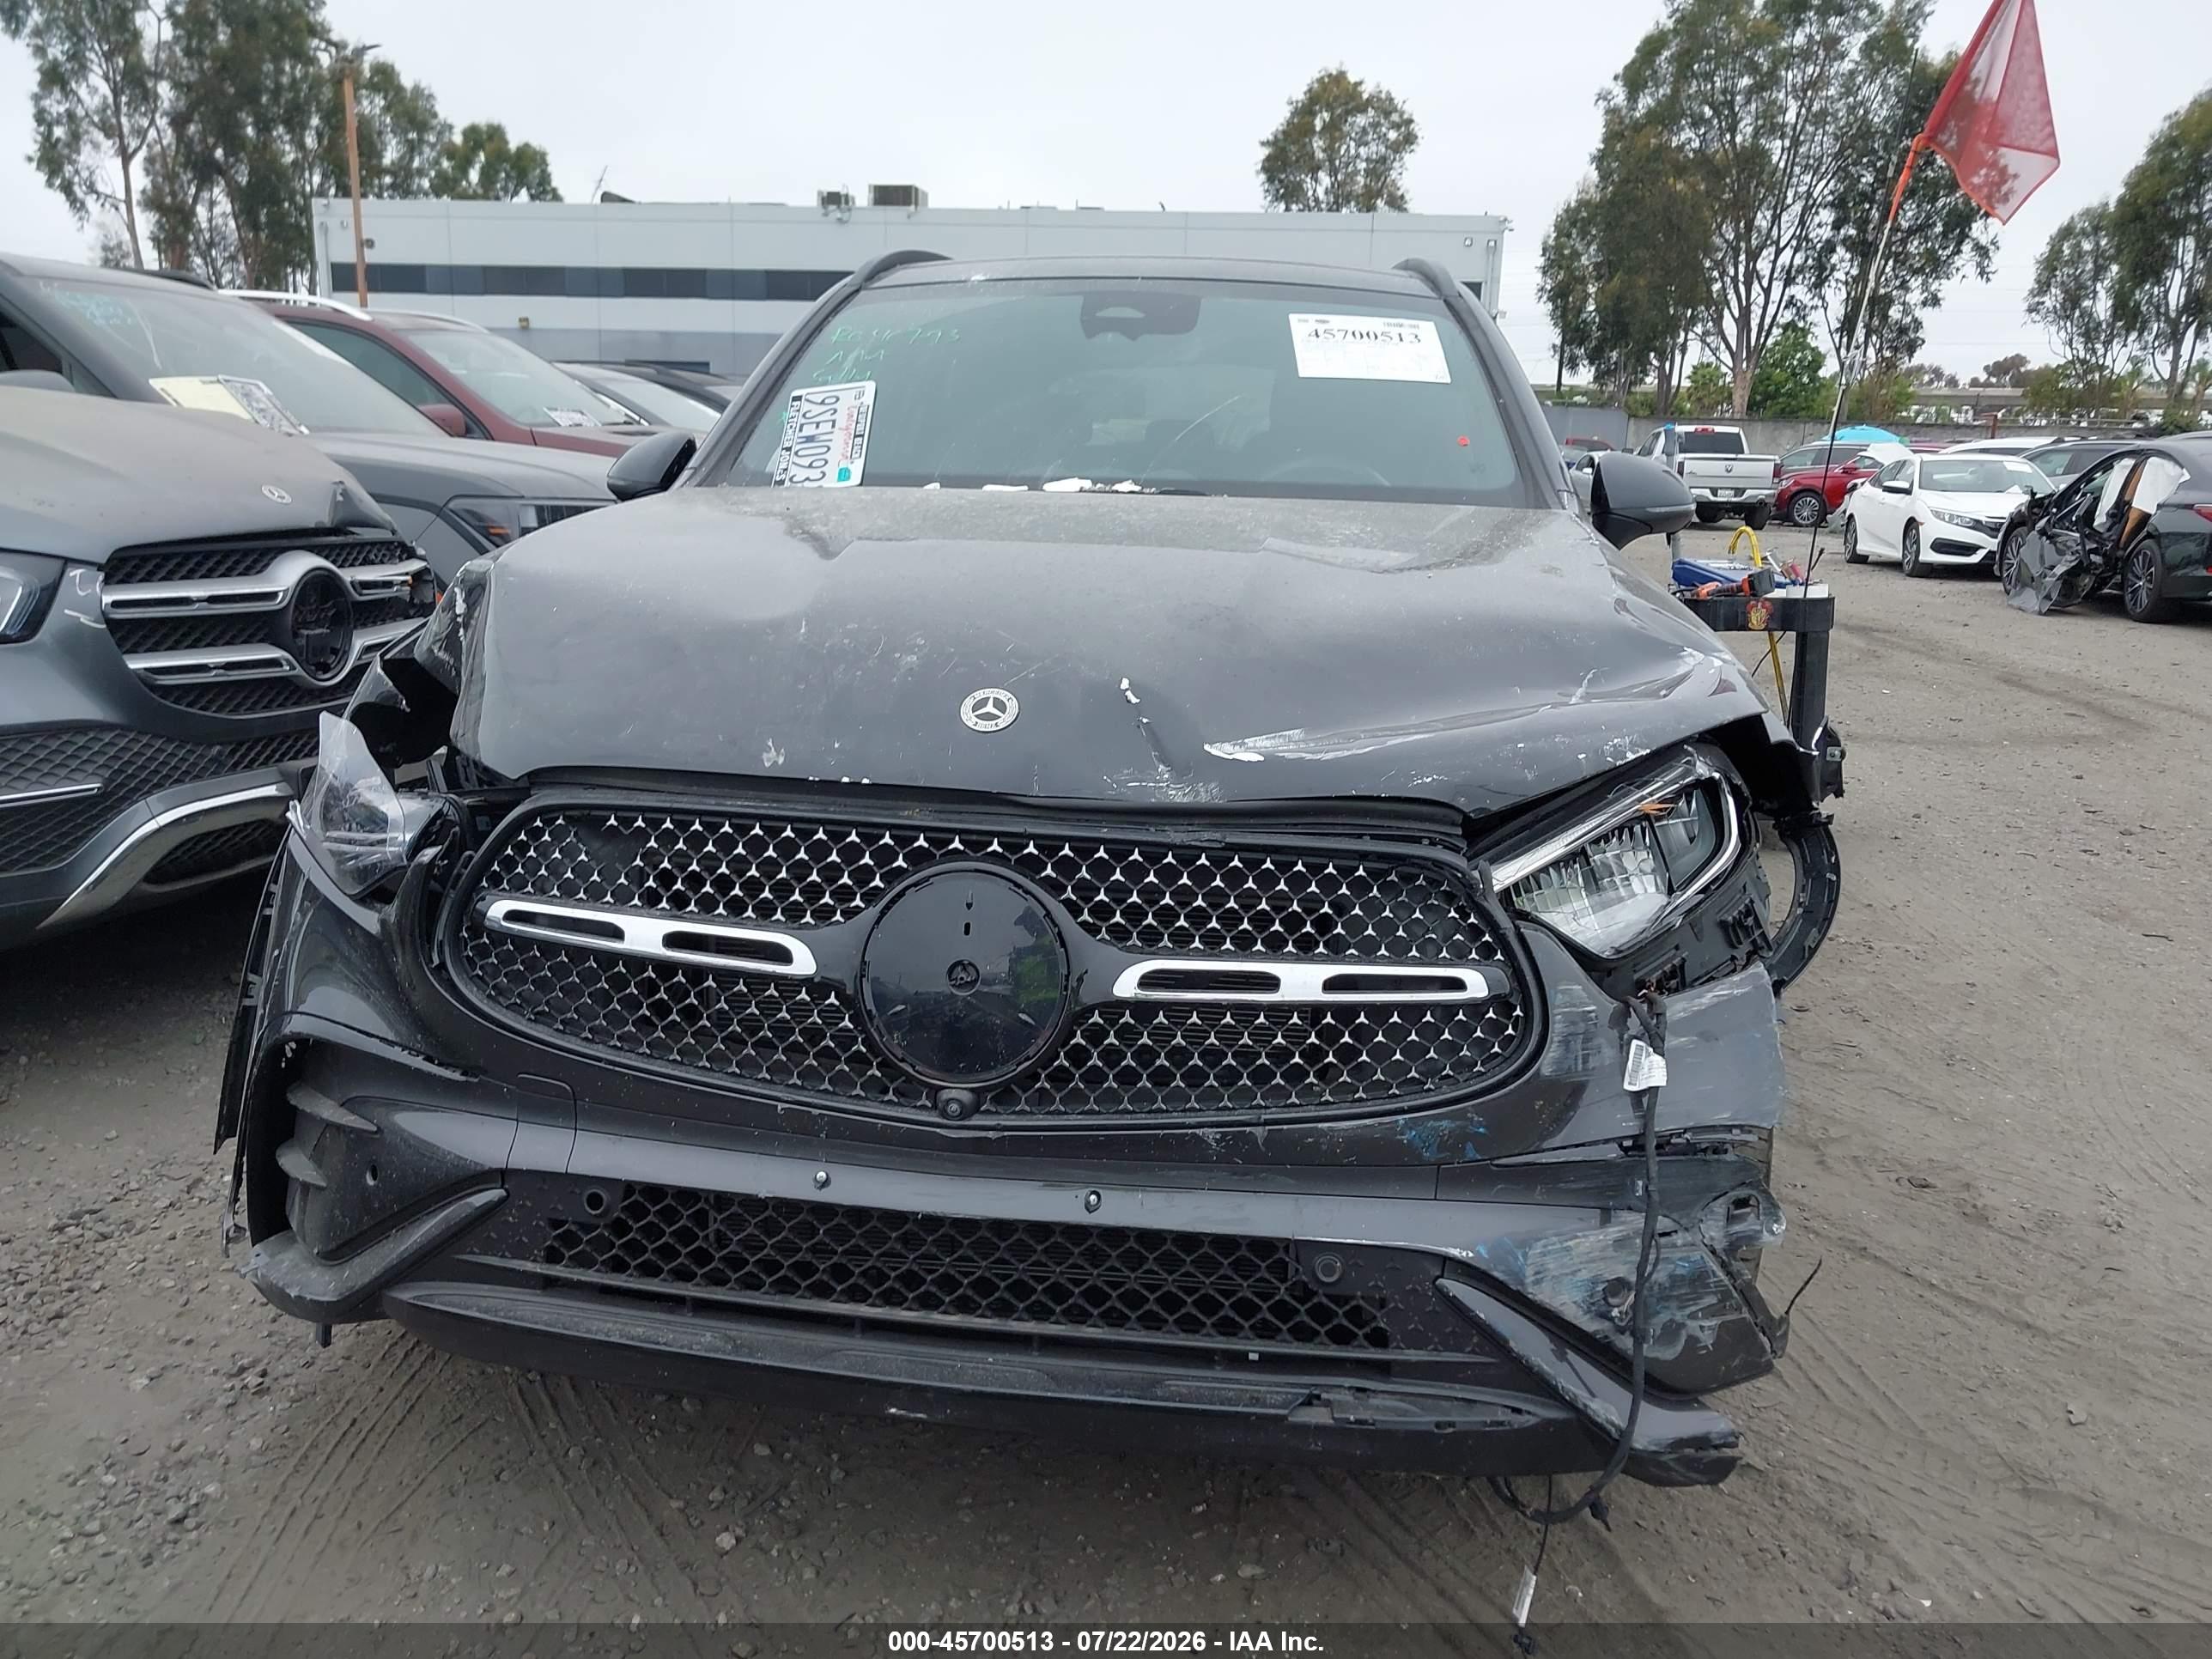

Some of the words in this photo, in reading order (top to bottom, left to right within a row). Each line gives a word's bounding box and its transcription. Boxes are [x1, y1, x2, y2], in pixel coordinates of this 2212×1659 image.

[1307, 328, 1422, 344] 45700513
[782, 400, 801, 448] FLETCHER
[775, 448, 792, 481] JONES
